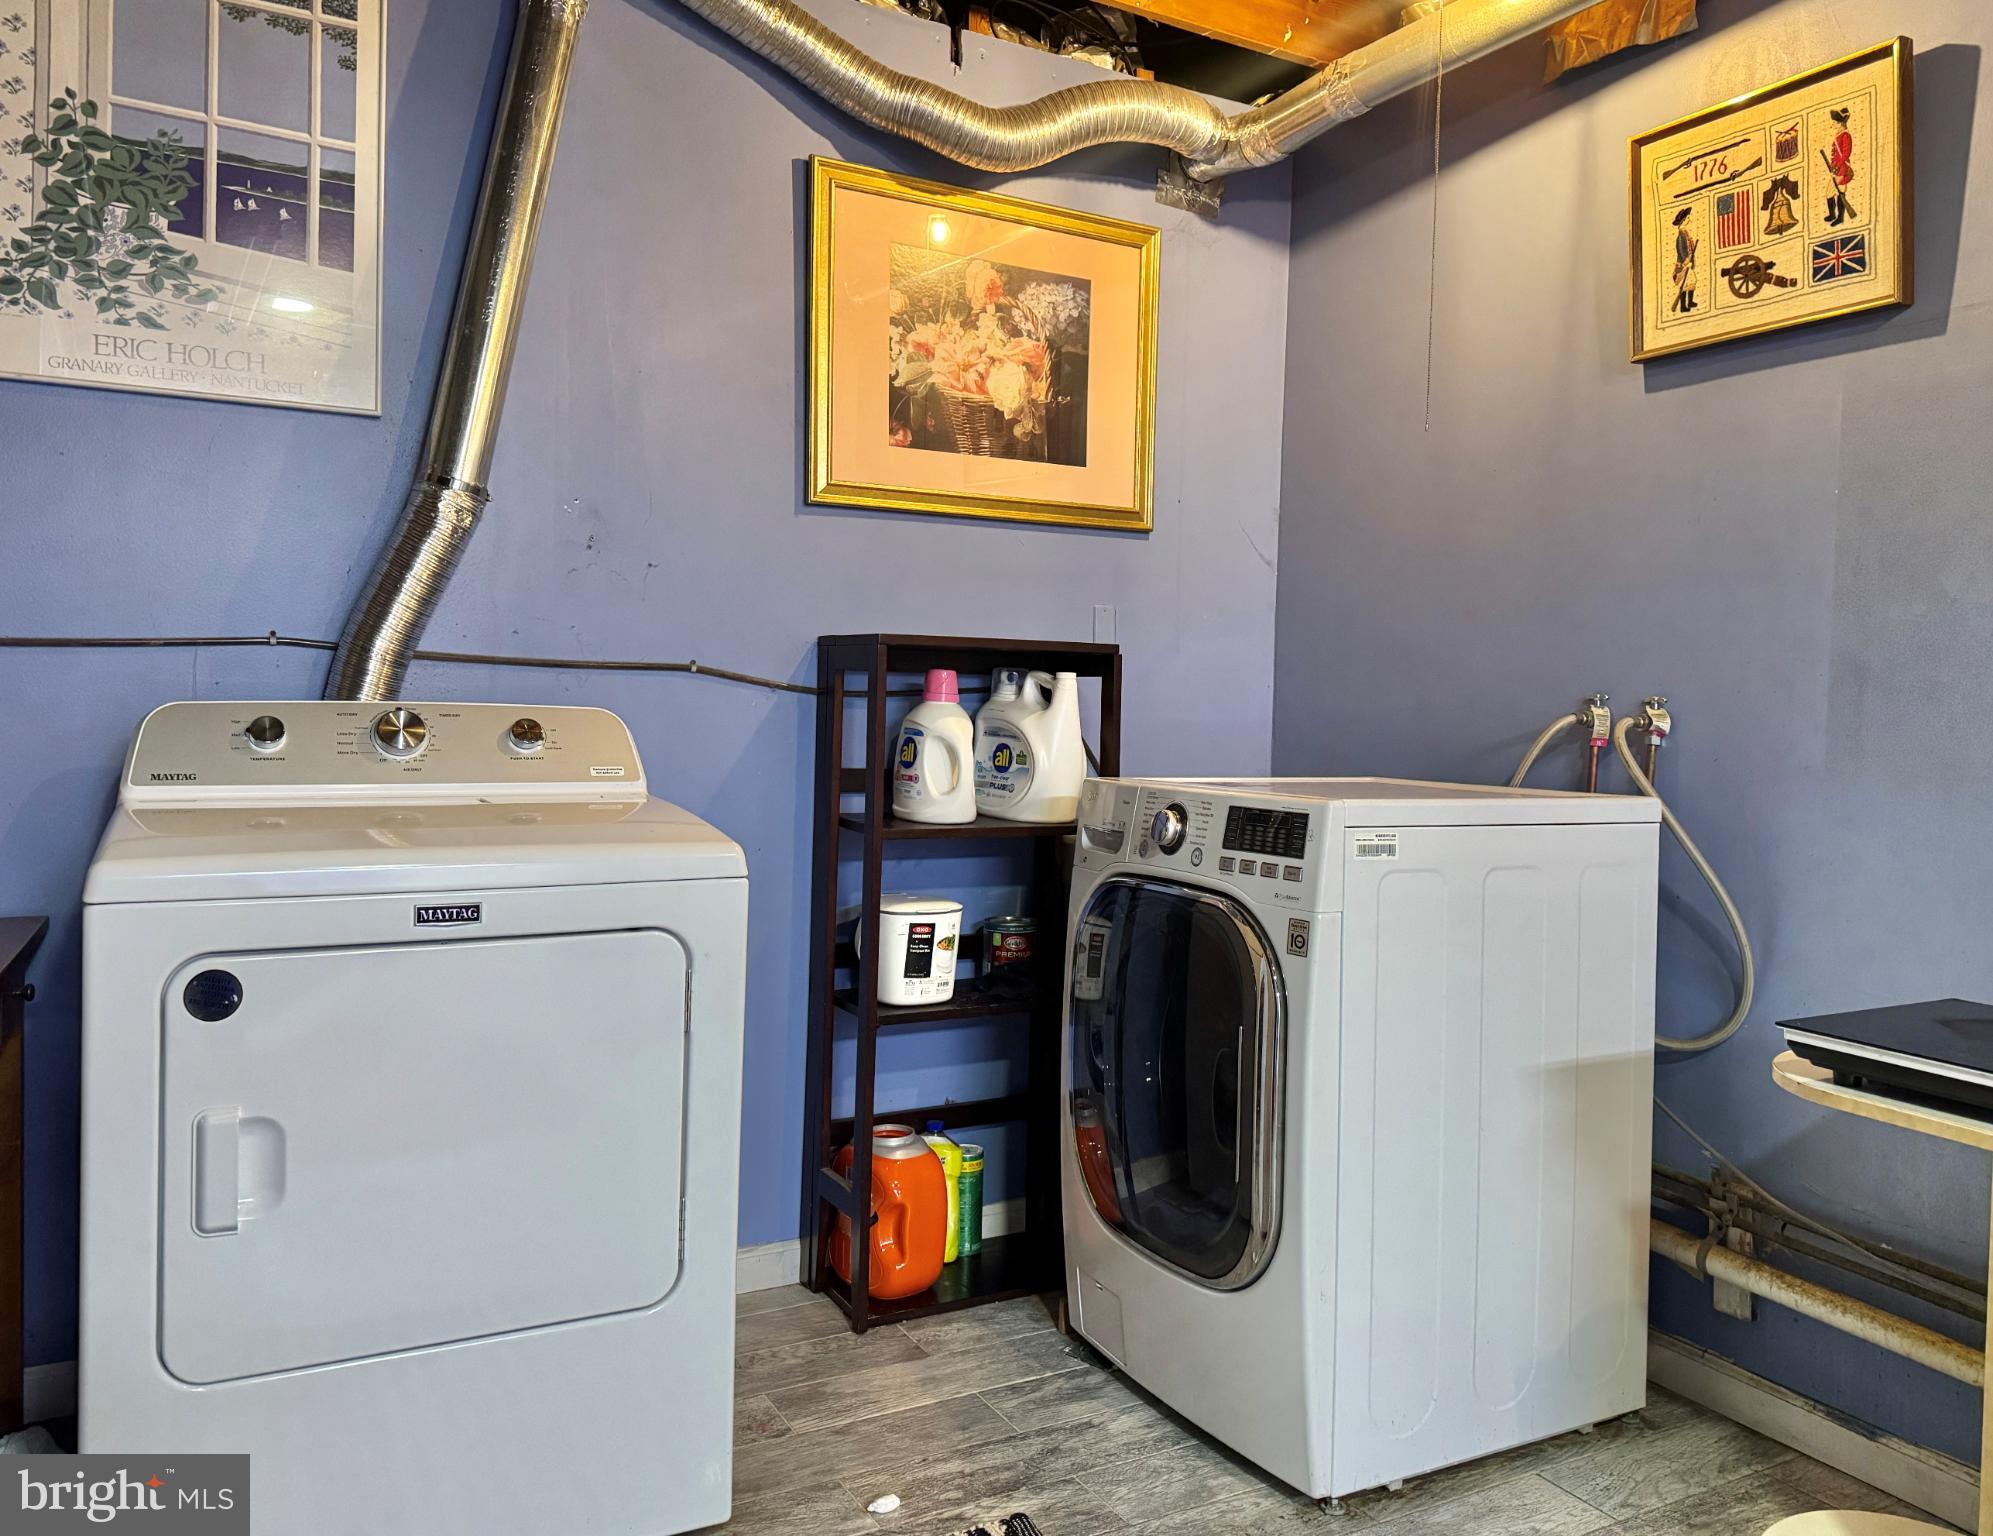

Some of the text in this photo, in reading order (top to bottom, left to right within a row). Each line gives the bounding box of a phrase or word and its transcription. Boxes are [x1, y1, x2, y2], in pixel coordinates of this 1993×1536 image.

[1693, 155, 1728, 182] 1776
[92, 333, 266, 374] ERIC HOLCH
[47, 355, 306, 395] GRANARY GALLERY NANTUCKET
[901, 743, 915, 762] all
[994, 748, 1010, 767] all
[150, 773, 197, 781] MAYTAG
[419, 908, 478, 920] MAYTAG
